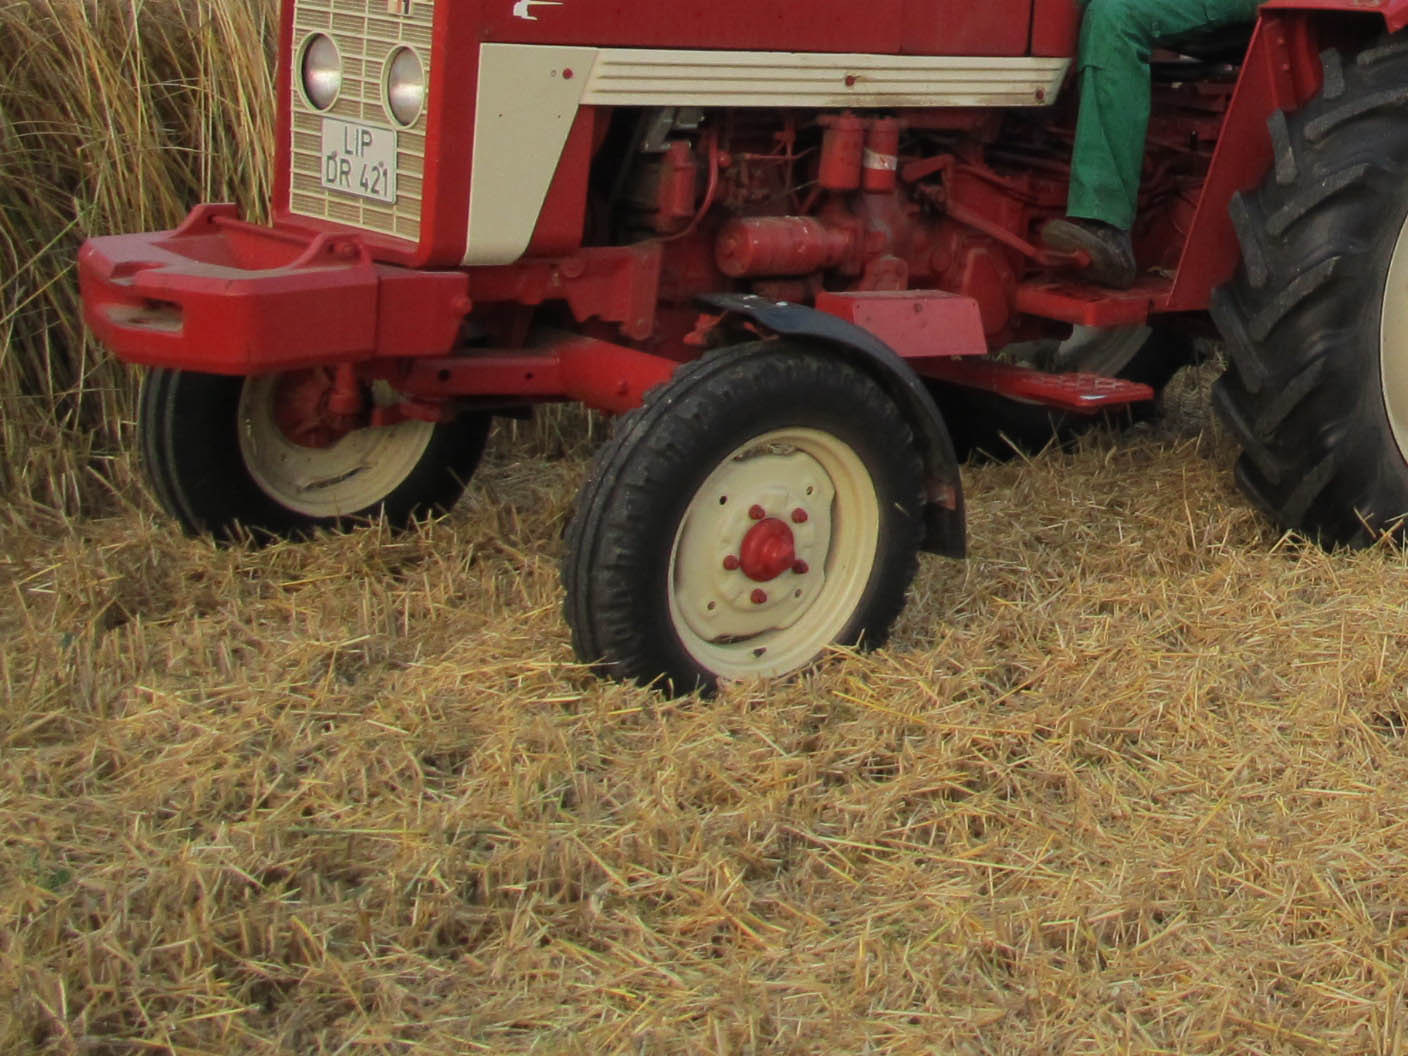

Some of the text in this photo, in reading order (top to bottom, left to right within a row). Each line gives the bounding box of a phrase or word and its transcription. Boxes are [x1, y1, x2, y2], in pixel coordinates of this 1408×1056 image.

[344, 125, 373, 159] LIP
[325, 154, 389, 198] DR 421
